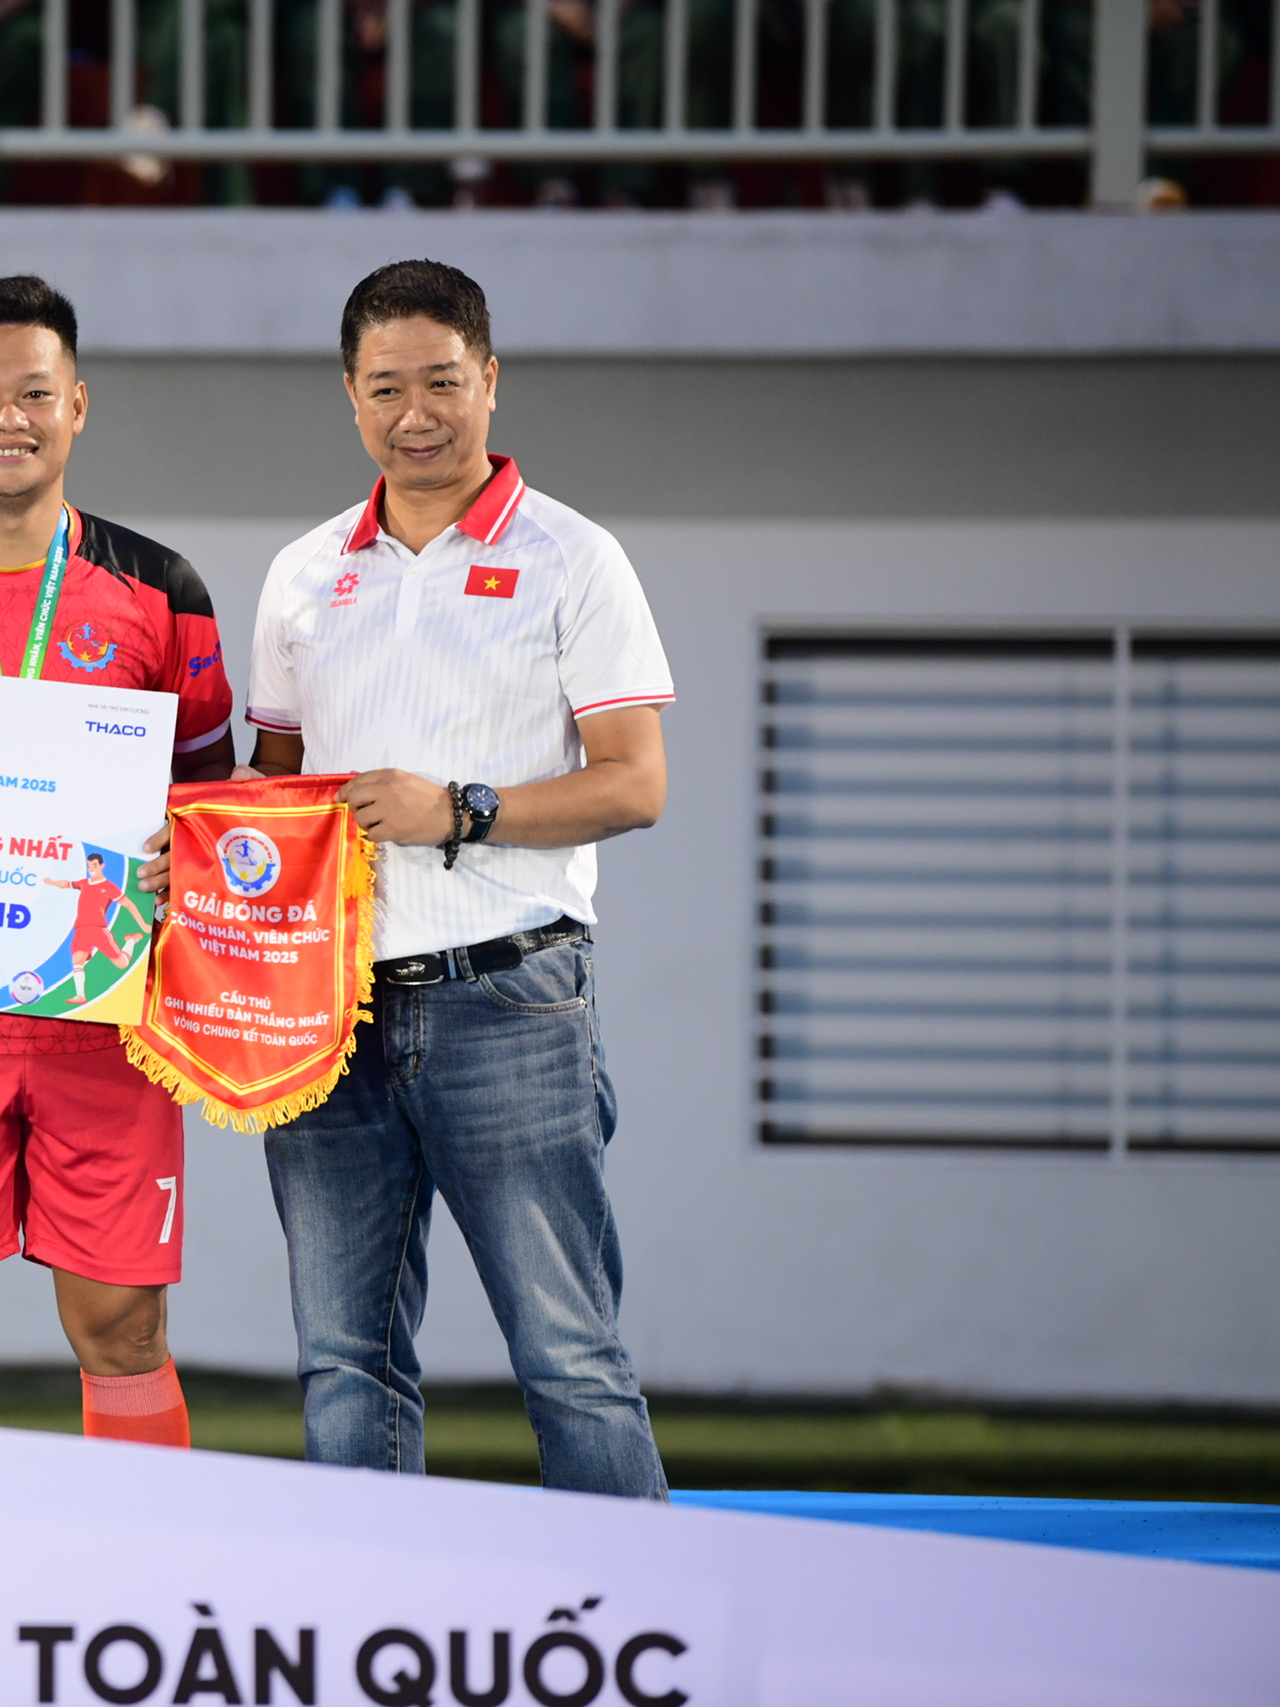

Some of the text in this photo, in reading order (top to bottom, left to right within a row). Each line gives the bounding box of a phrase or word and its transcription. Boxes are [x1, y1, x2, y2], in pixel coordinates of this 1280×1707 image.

[85, 720, 146, 737] THACO
[20, 778, 56, 793] 2025
[8, 835, 73, 861] NHẤT
[184, 890, 317, 923] GIẢI BÓNG ĐÁ
[208, 924, 250, 944] NHÂN,
[253, 930, 288, 944] VIÊN
[291, 928, 330, 944] CHỨC
[200, 937, 298, 964] VIỆT NAM 2025
[165, 996, 184, 1010] GHI
[226, 1007, 251, 1022] BÀN
[254, 1010, 296, 1028] THẮNG
[299, 1010, 329, 1026] NHẤT
[248, 995, 271, 1010] THỦ
[174, 1015, 318, 1046] VÒNG CHUNG KẾT TOÀN QUỐC
[155, 1176, 177, 1244] 7
[18, 1602, 316, 1707] TOÀN
[355, 1596, 691, 1707] QUỐC
